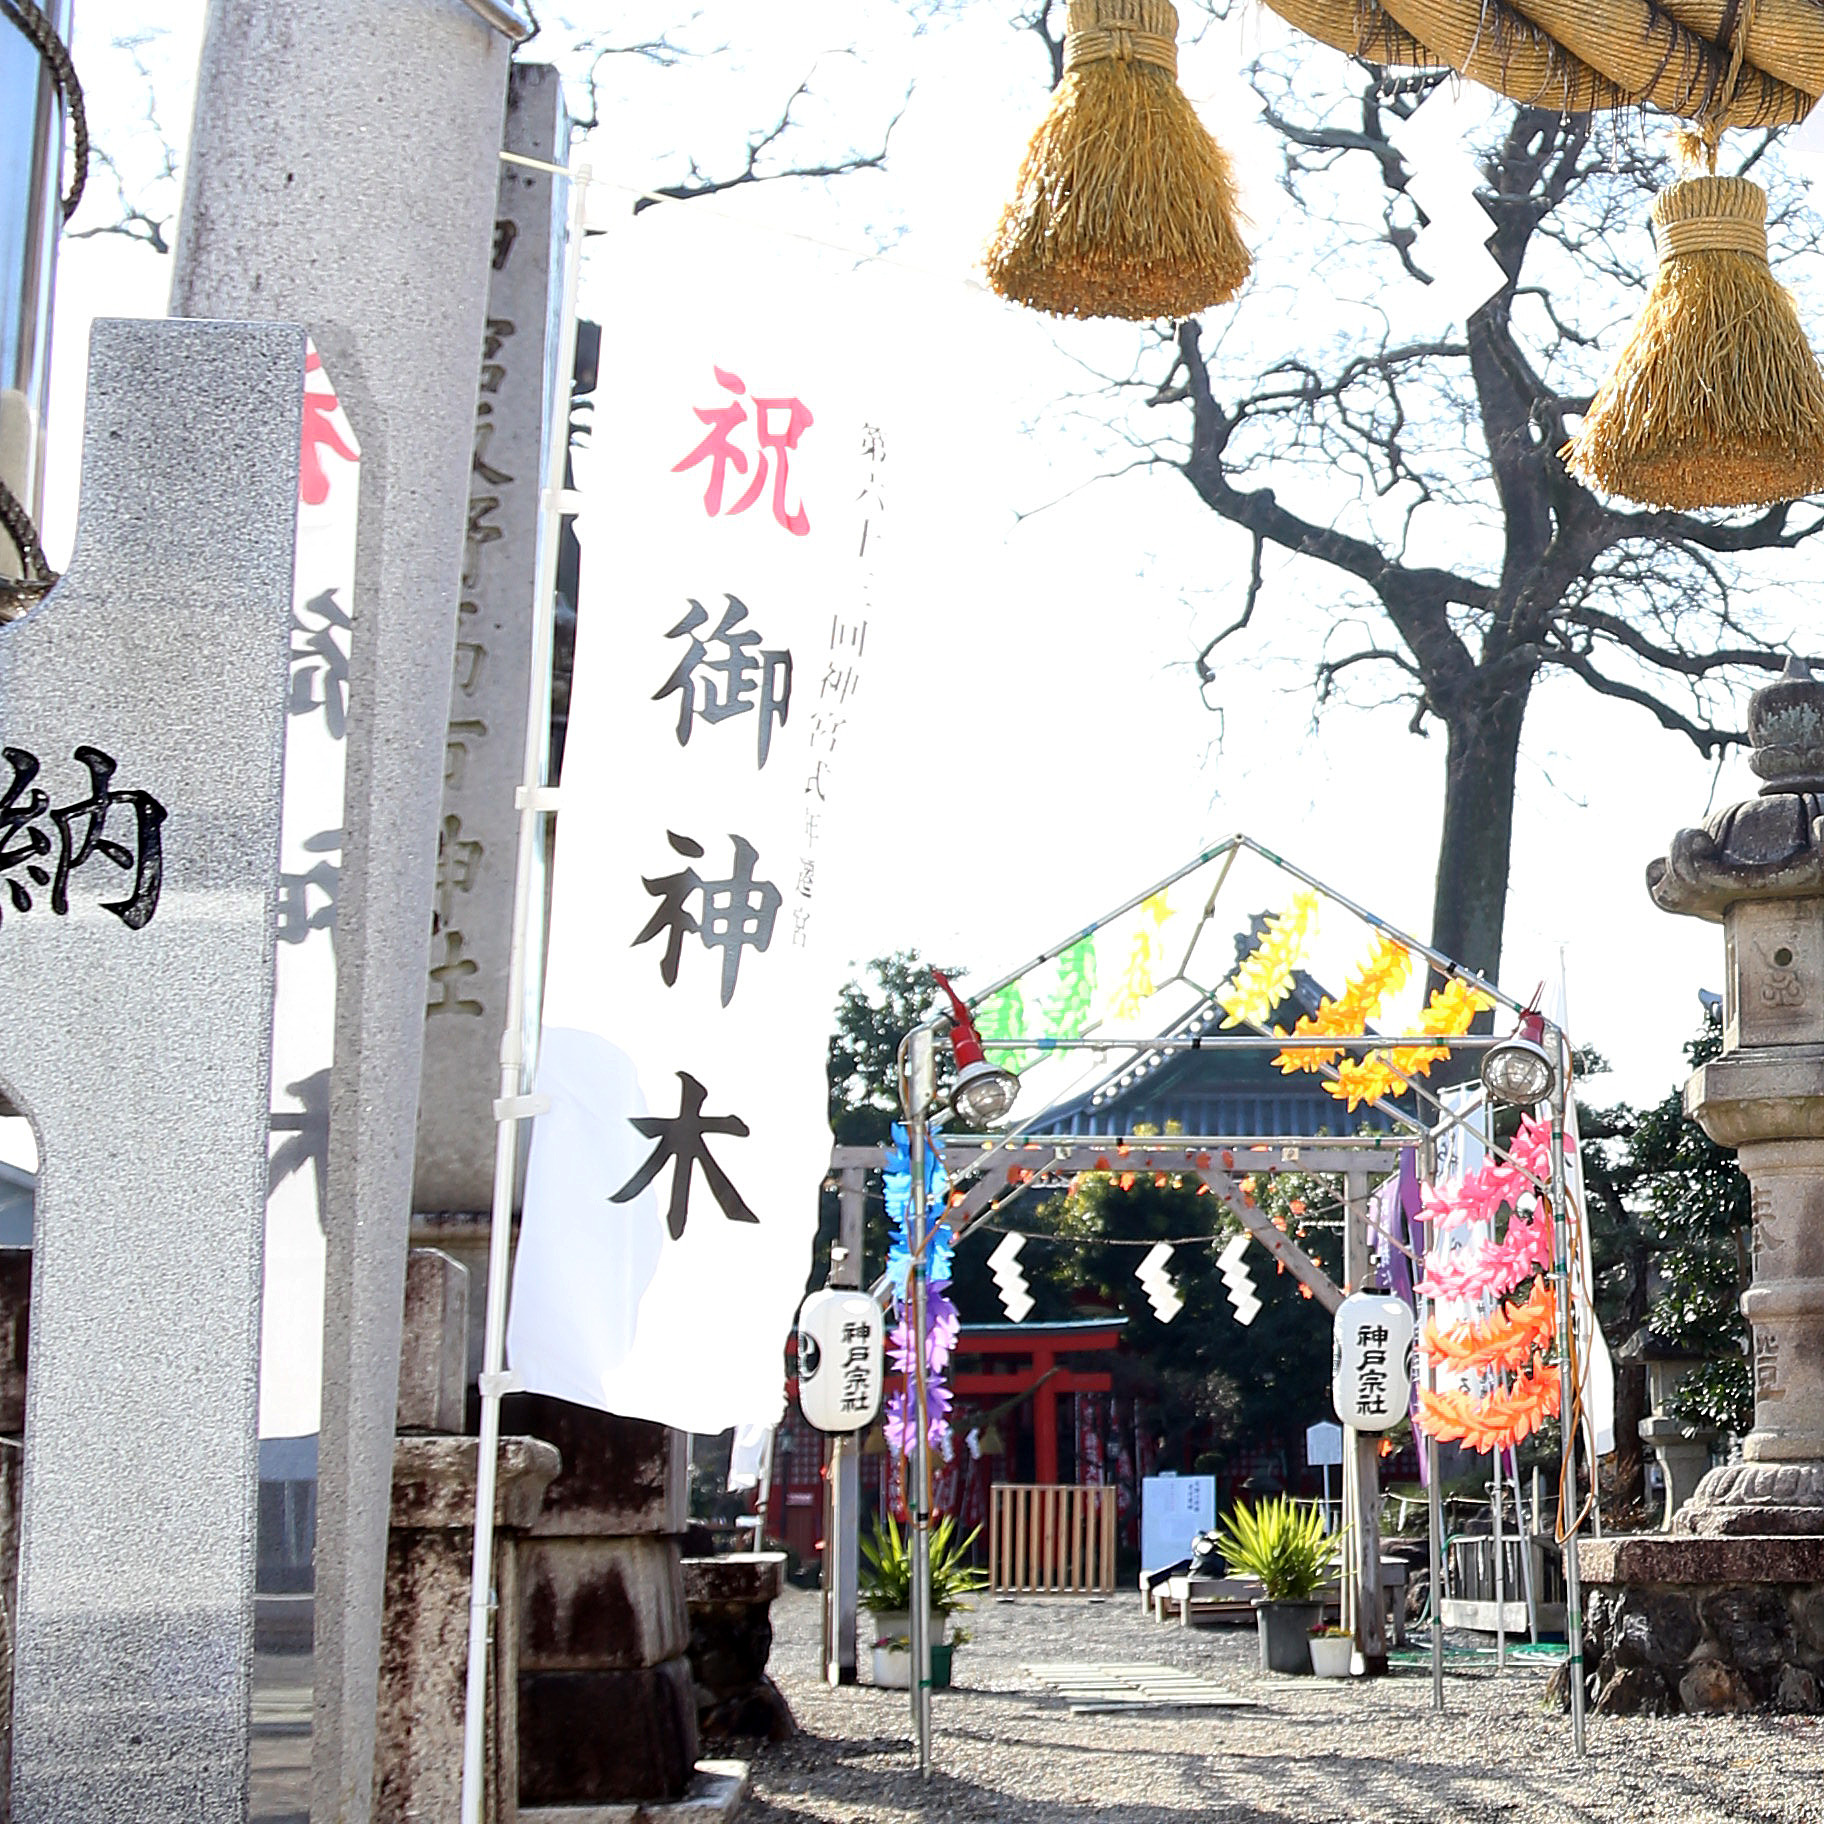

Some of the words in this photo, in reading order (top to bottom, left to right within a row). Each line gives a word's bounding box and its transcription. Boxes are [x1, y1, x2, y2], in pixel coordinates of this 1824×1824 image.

[0, 745, 168, 931] 納
[608, 366, 815, 1242] 祝御神木
[841, 1321, 871, 1413] 神戸宗社
[1356, 1324, 1390, 1416] 神戸宗社
